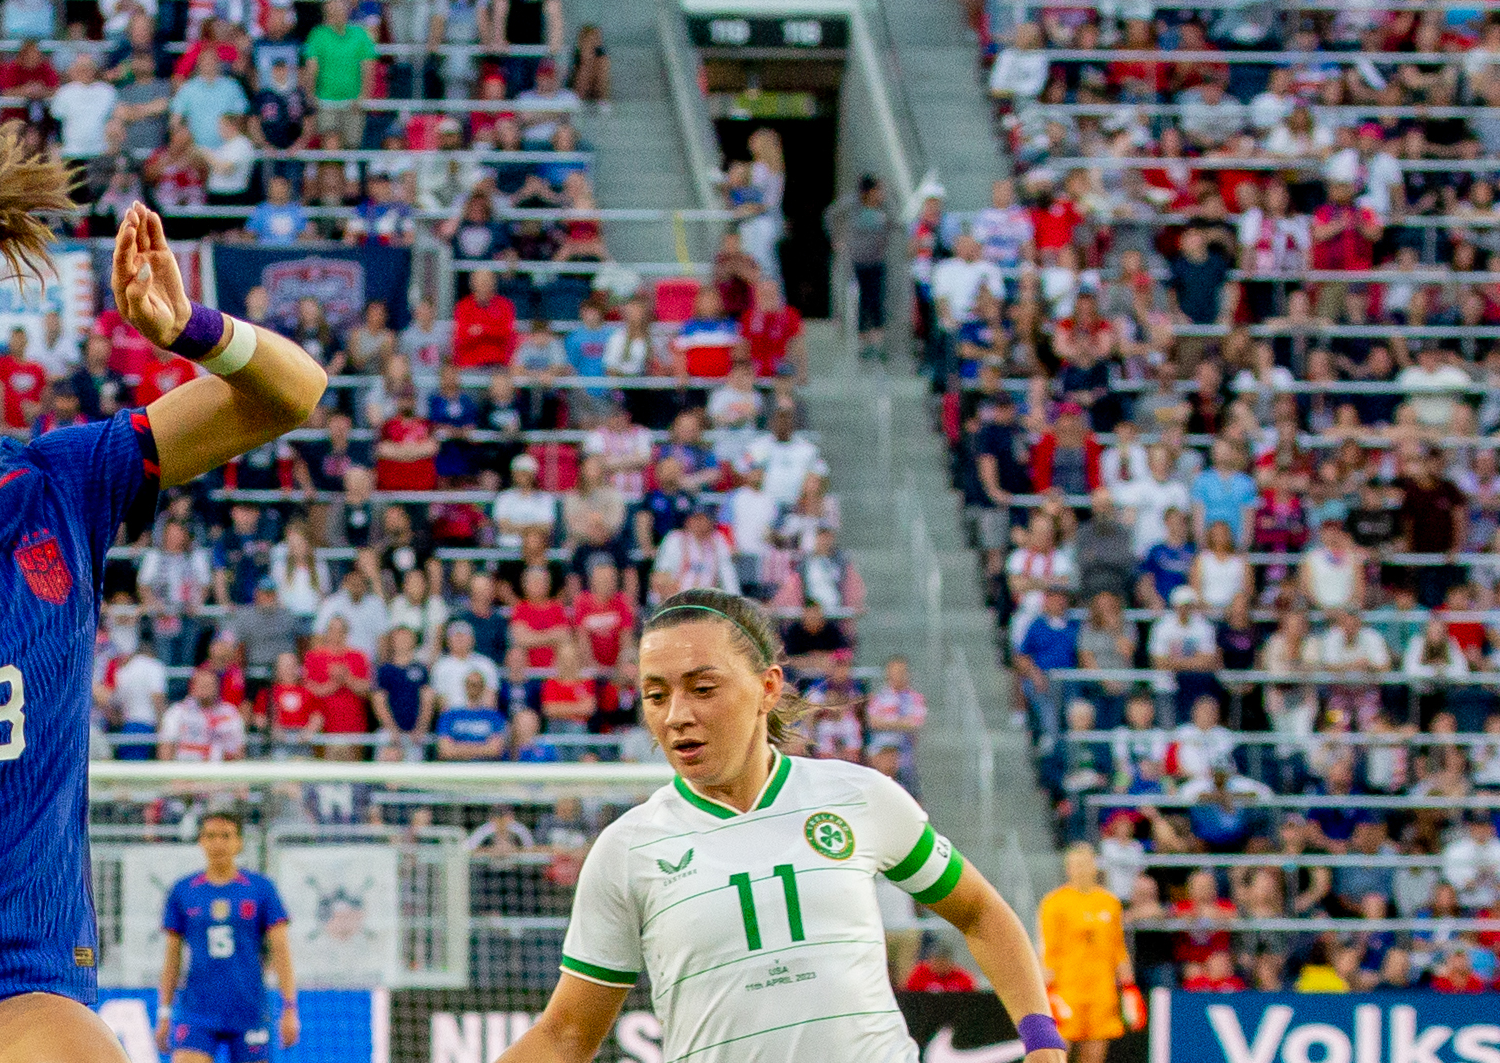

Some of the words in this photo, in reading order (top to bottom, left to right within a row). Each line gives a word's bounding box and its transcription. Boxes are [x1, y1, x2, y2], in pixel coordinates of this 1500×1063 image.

[18, 542, 57, 572] USA
[728, 863, 806, 952] 11
[766, 976, 793, 987] APRIL
[795, 971, 817, 982] 2023
[768, 966, 788, 976] USA
